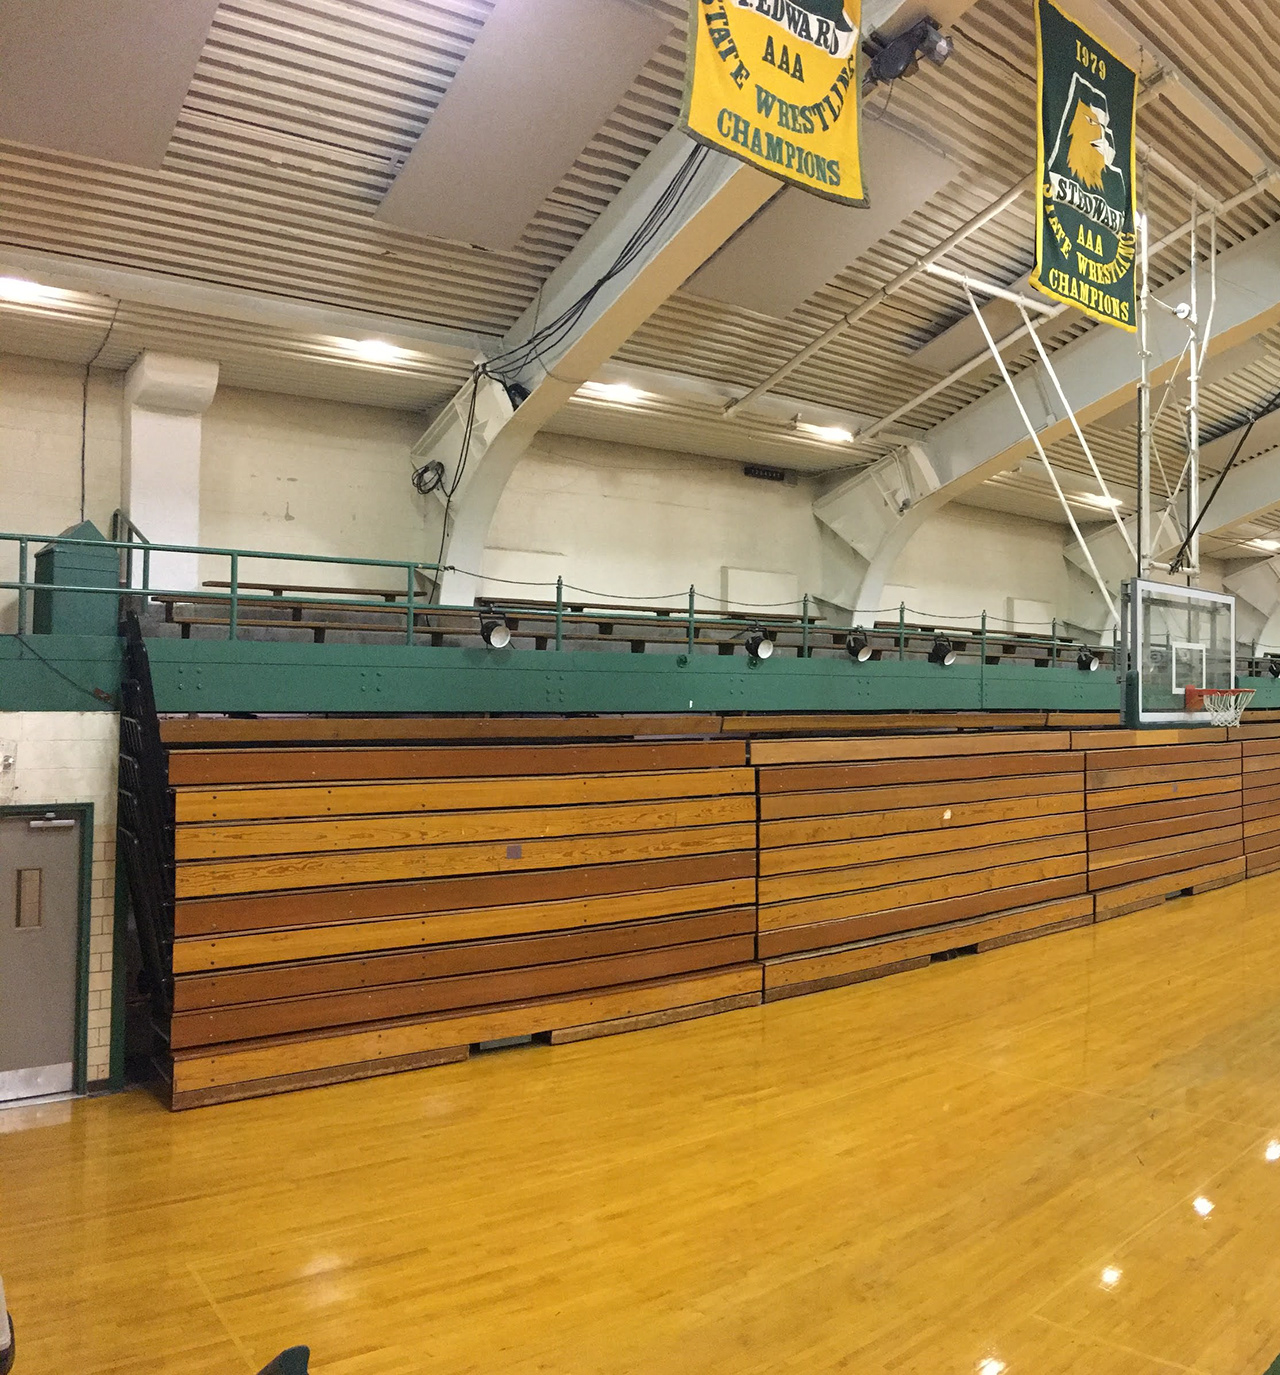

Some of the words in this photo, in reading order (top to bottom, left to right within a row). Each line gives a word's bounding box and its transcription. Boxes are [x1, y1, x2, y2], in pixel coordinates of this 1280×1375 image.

[756, 0, 839, 55] EDWARD
[762, 35, 804, 82] AAA
[1075, 39, 1107, 80] 1979
[755, 54, 854, 134] WRESTLING
[717, 108, 840, 186] CHAMPIONS
[1076, 224, 1103, 256] AAA
[1076, 232, 1136, 284] WRESTLING
[1049, 268, 1129, 321] CHAMPIONS
